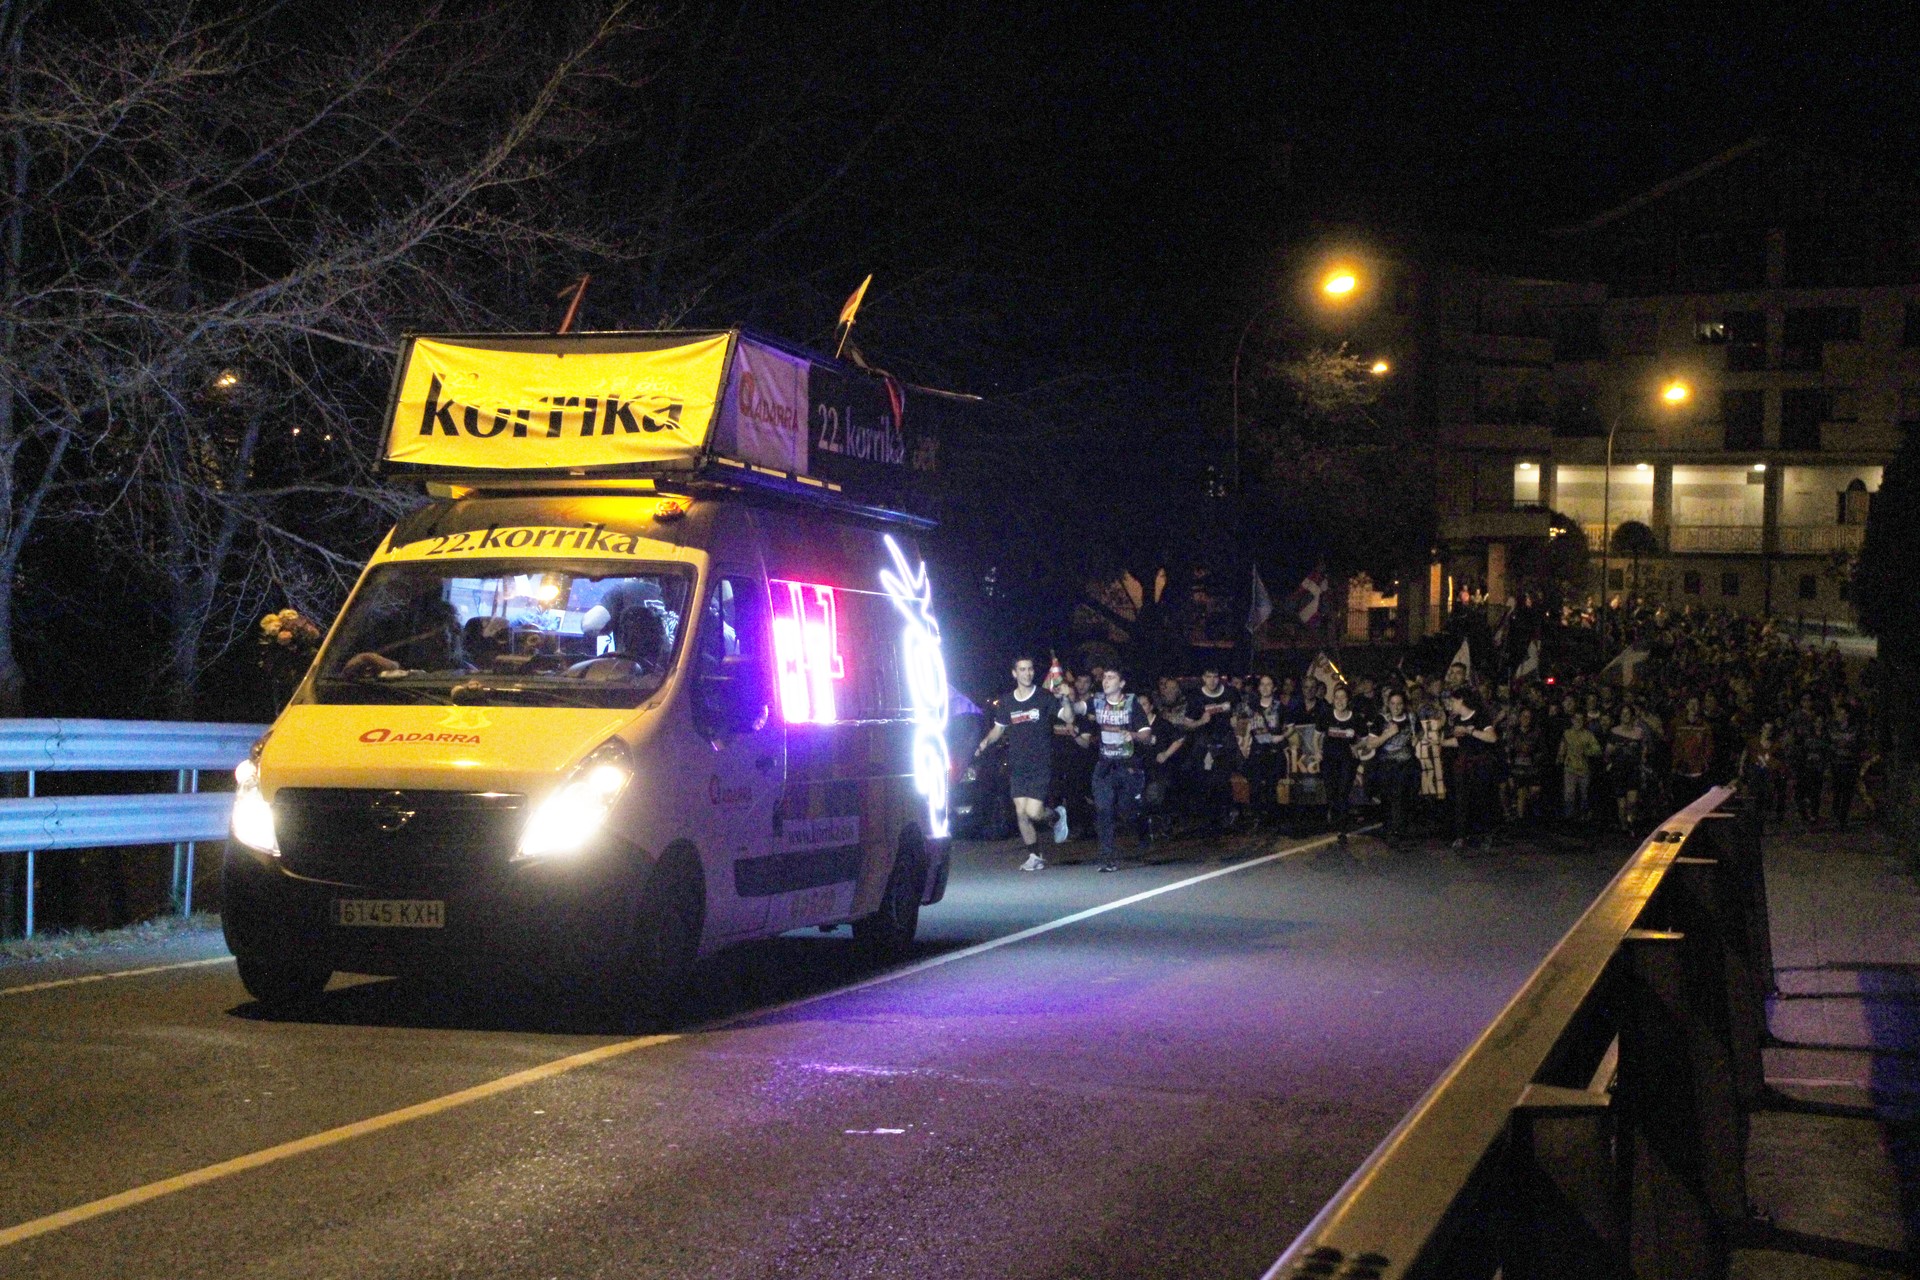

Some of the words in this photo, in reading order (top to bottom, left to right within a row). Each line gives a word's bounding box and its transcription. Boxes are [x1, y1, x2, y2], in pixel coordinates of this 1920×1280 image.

[419, 371, 684, 438] korrika
[426, 523, 640, 556] 22.korrika
[390, 733, 481, 744] ADARRA
[344, 902, 393, 923] 6145
[400, 902, 440, 923] KXH
